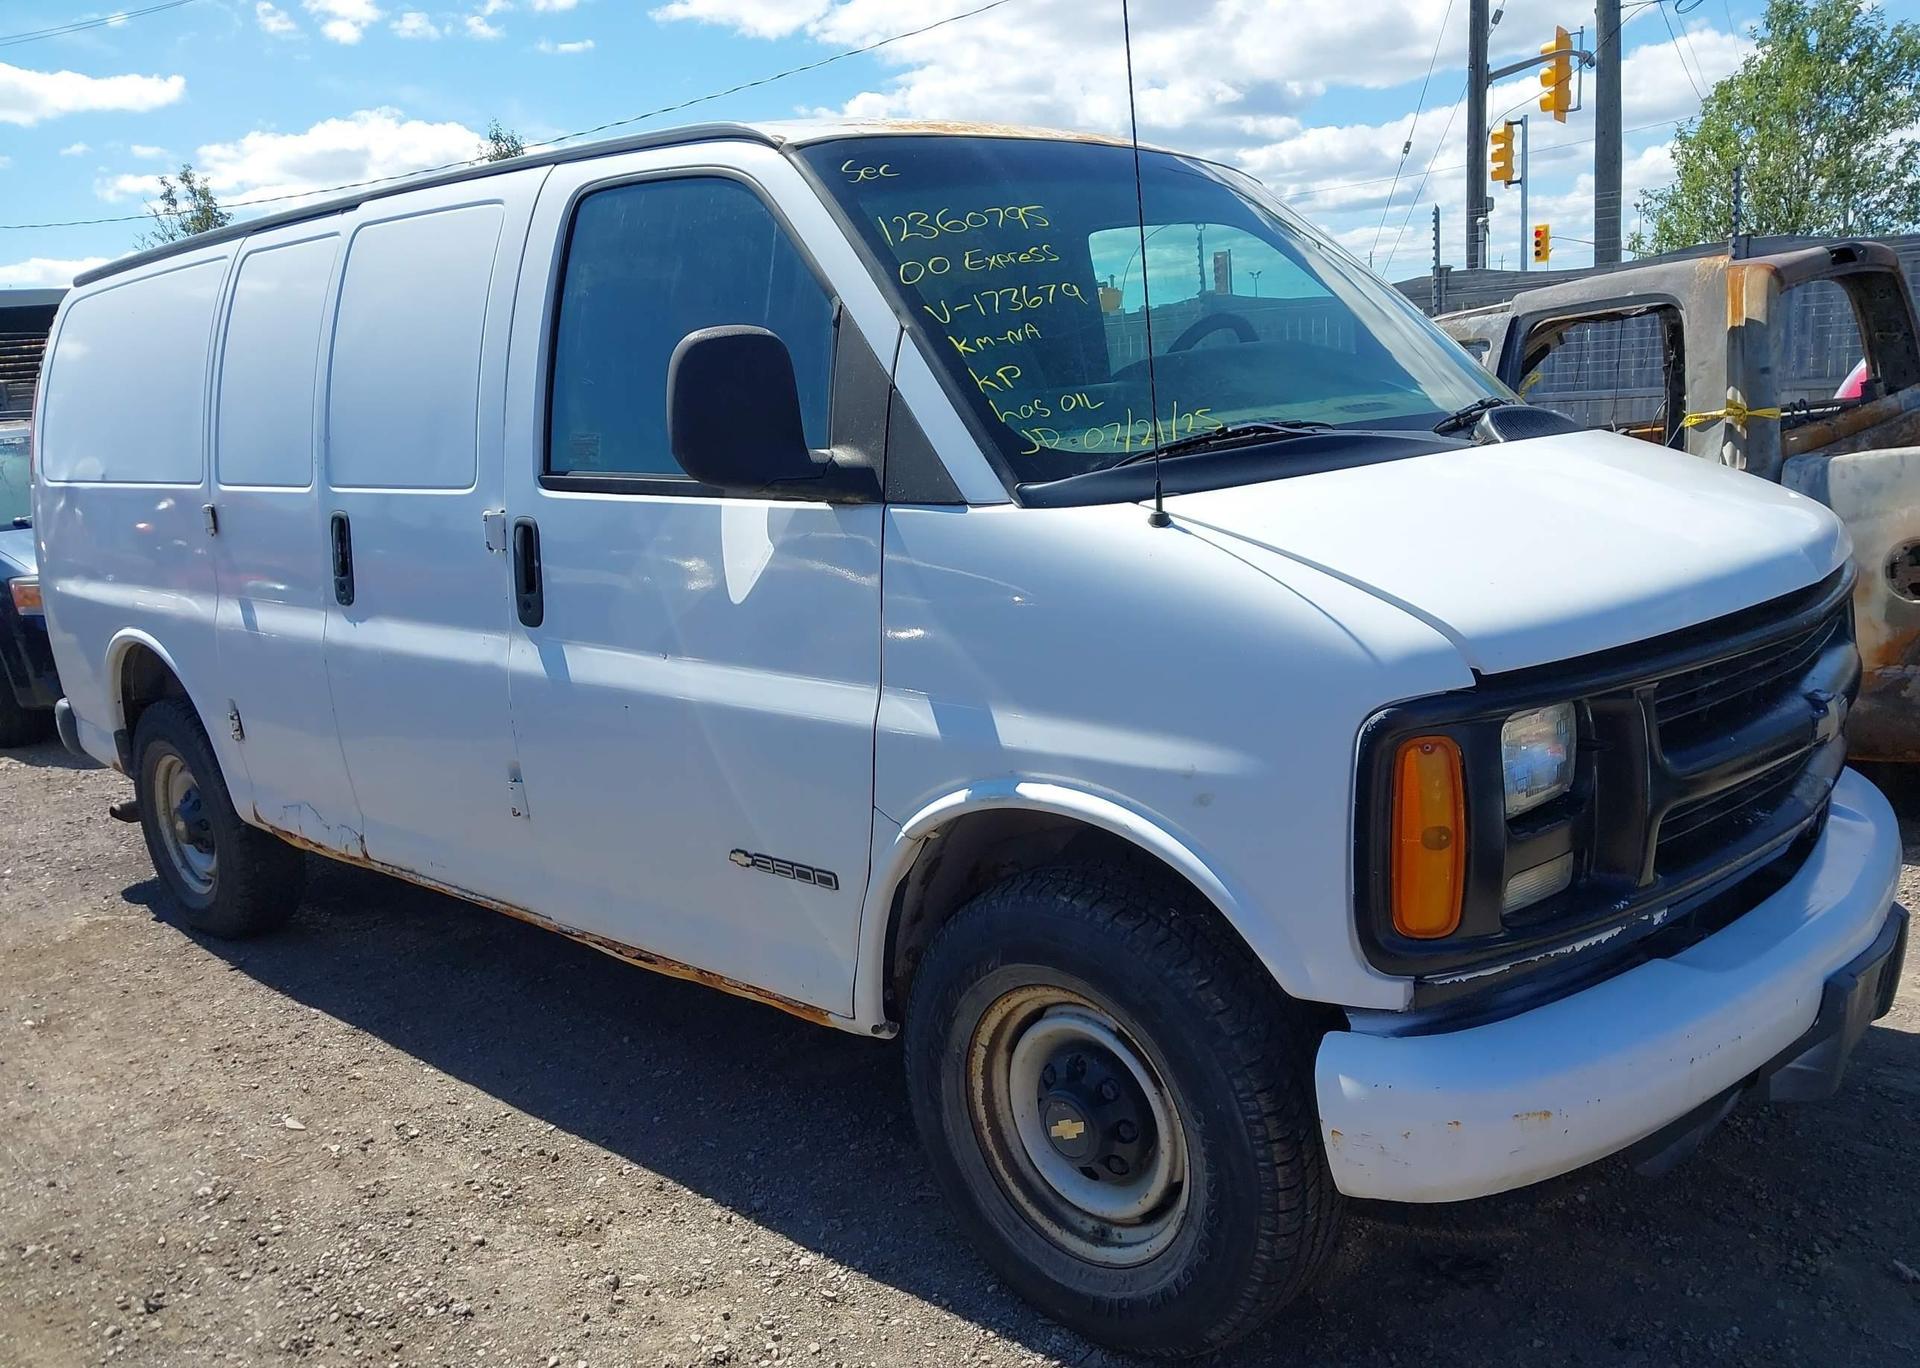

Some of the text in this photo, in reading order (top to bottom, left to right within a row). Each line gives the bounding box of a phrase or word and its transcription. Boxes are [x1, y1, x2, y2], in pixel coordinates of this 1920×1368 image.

[841, 159, 901, 183] Sec
[877, 205, 1049, 247] 12360795
[963, 244, 1060, 272] Express
[1083, 400, 1224, 453] 07/21/25
[753, 852, 840, 891] 3500
